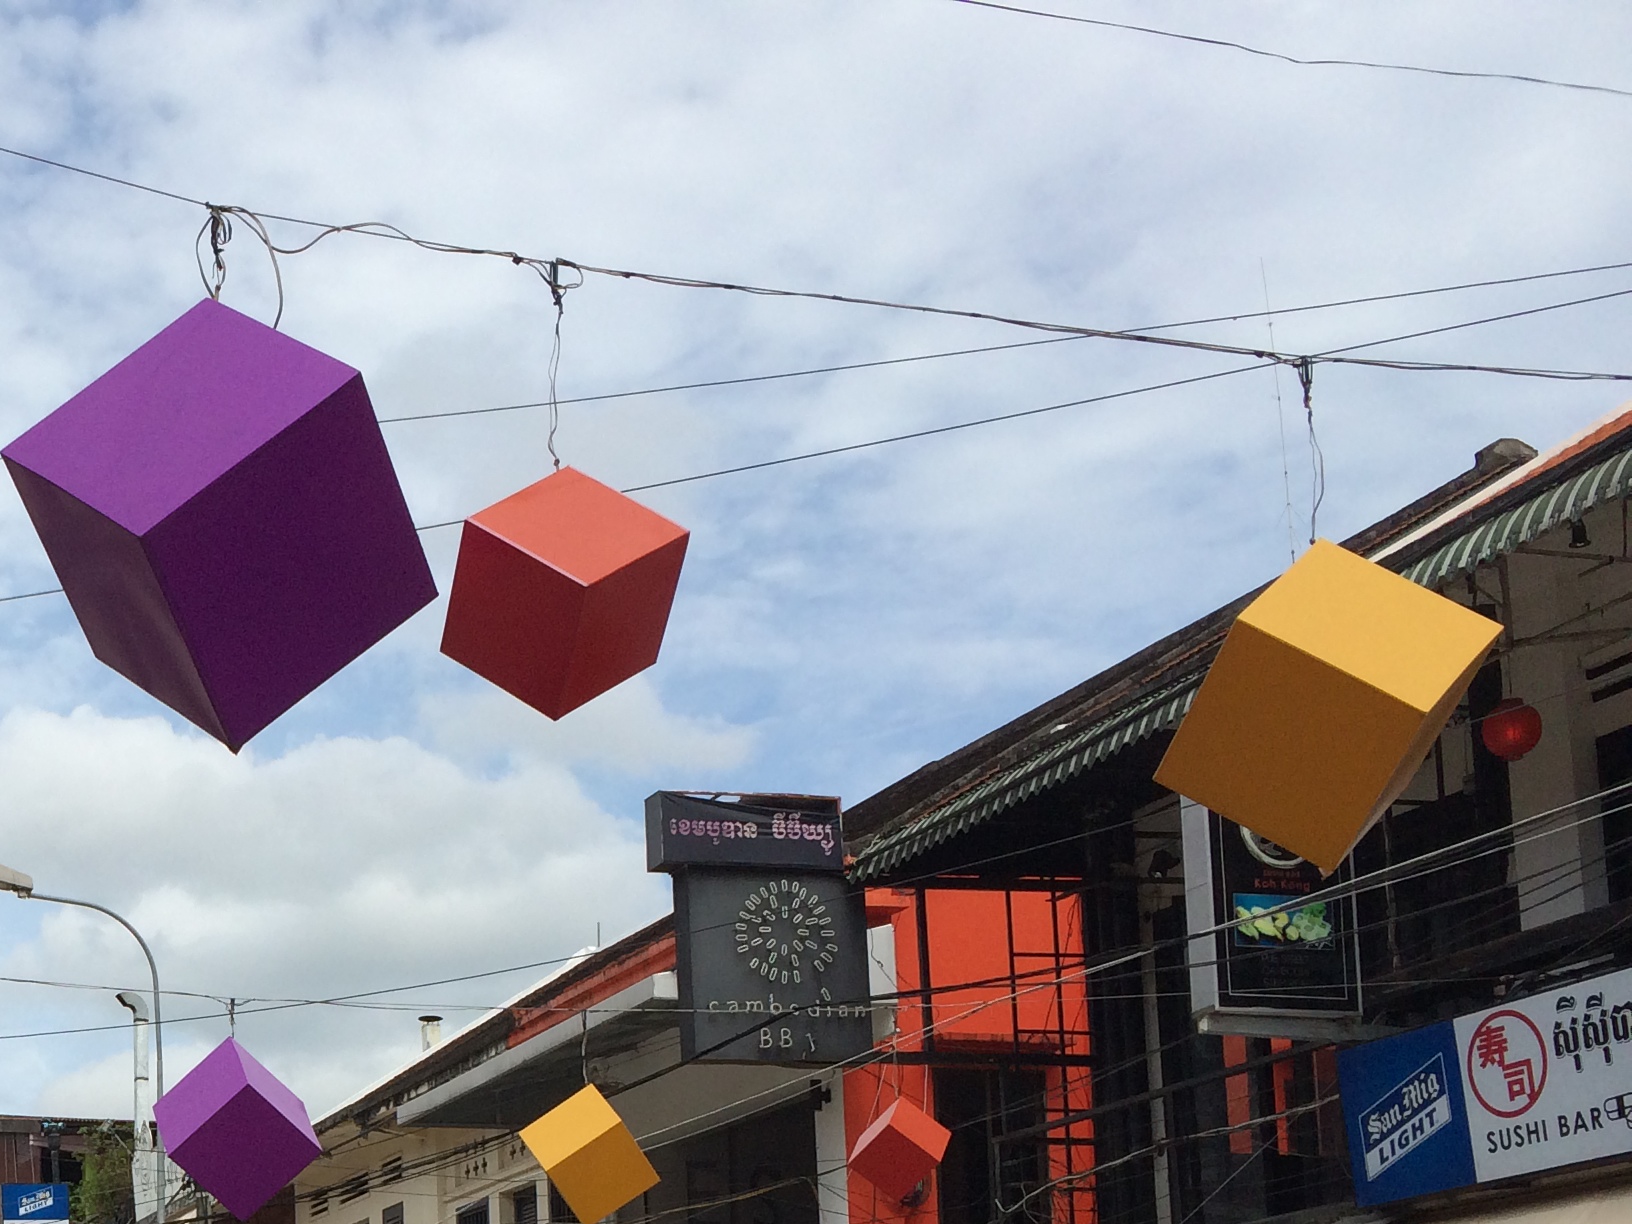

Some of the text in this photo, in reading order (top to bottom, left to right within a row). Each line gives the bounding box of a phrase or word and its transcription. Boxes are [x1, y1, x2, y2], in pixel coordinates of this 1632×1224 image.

[1367, 1071, 1441, 1145] San Mig
[1378, 1106, 1438, 1167] LIGHT
[1487, 1107, 1605, 1154] SUSHI BAR
